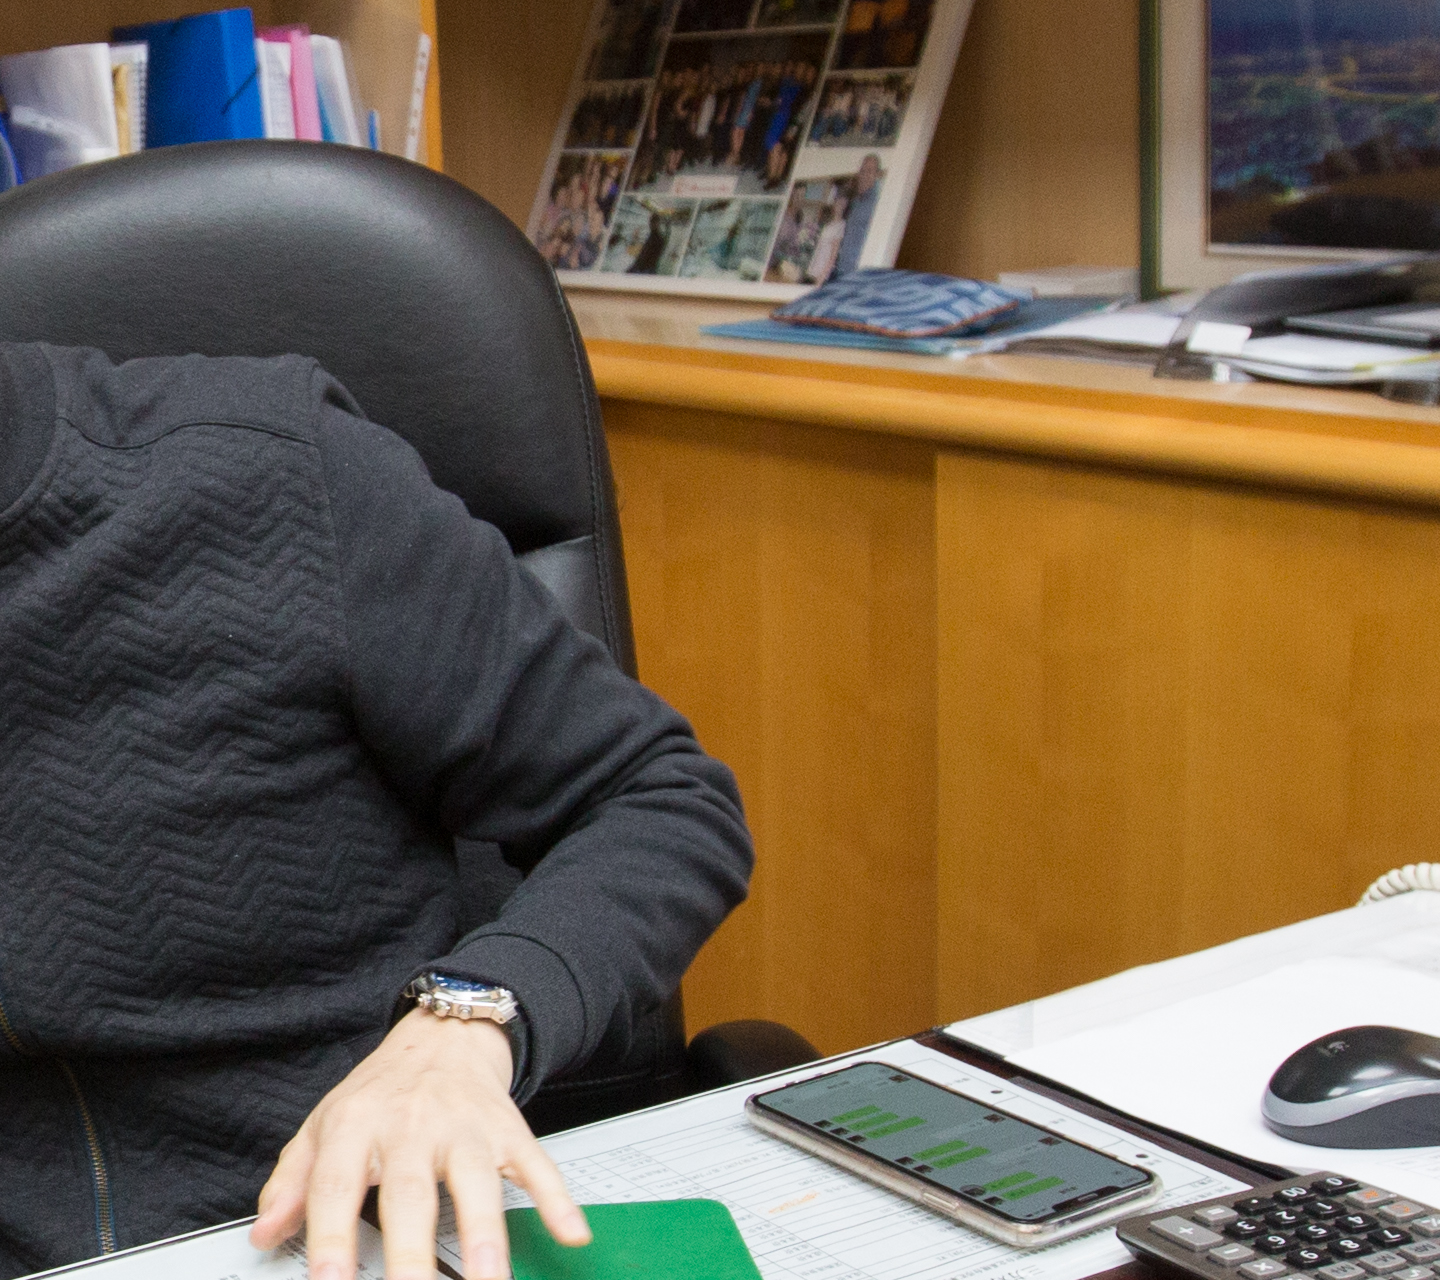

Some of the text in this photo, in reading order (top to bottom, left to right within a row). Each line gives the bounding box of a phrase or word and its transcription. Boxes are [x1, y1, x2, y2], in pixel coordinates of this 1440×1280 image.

[1325, 1176, 1343, 1188] 0
[1281, 1187, 1307, 1197] 00
[1316, 1202, 1333, 1211] 1
[1275, 1210, 1296, 1221] 2
[1347, 1215, 1364, 1225] 4
[1236, 1220, 1256, 1231] 3
[1308, 1225, 1327, 1235] 5
[1267, 1235, 1286, 1245] 6
[1383, 1229, 1401, 1241] 7
[1339, 1238, 1361, 1250] 8
[1300, 1250, 1319, 1260] 9
